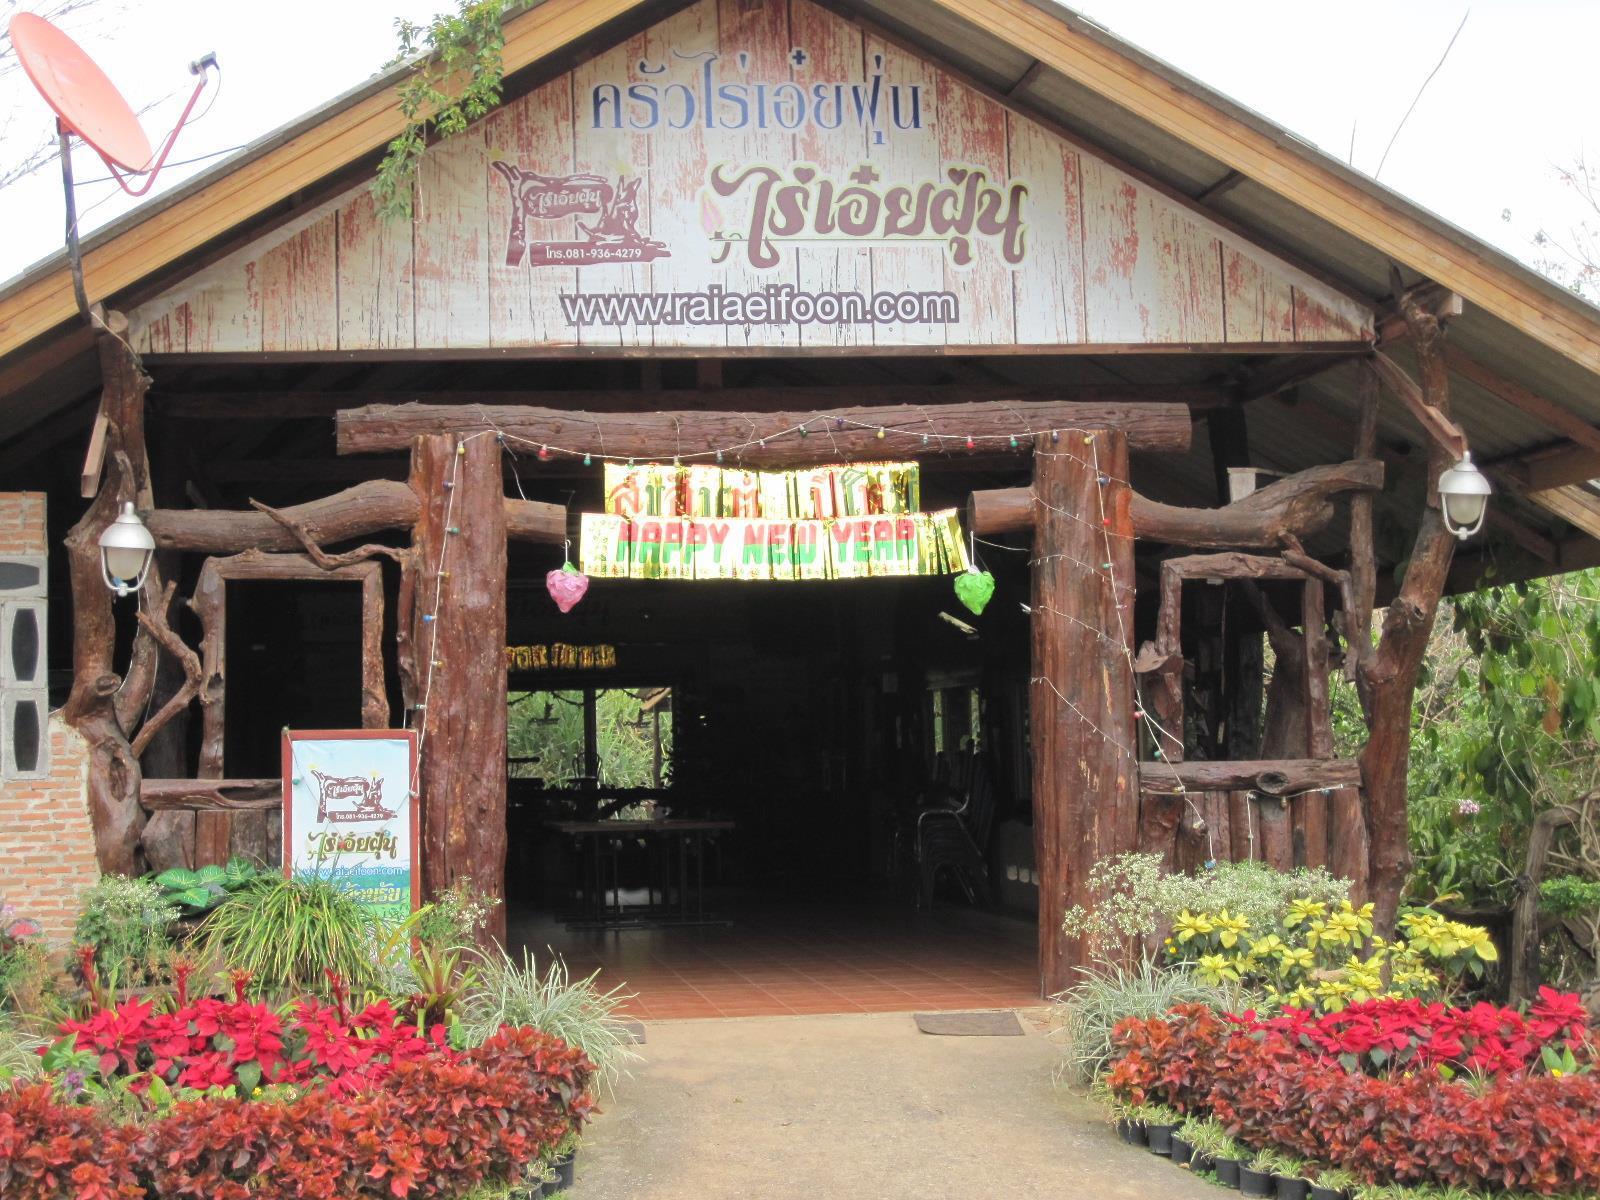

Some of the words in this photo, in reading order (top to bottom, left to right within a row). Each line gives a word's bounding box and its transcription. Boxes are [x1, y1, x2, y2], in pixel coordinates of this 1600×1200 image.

[561, 284, 960, 325] www.raiaeifoon.com
[616, 521, 730, 564] HAPPY
[742, 523, 817, 565] NEW
[832, 518, 915, 564] YEAR
